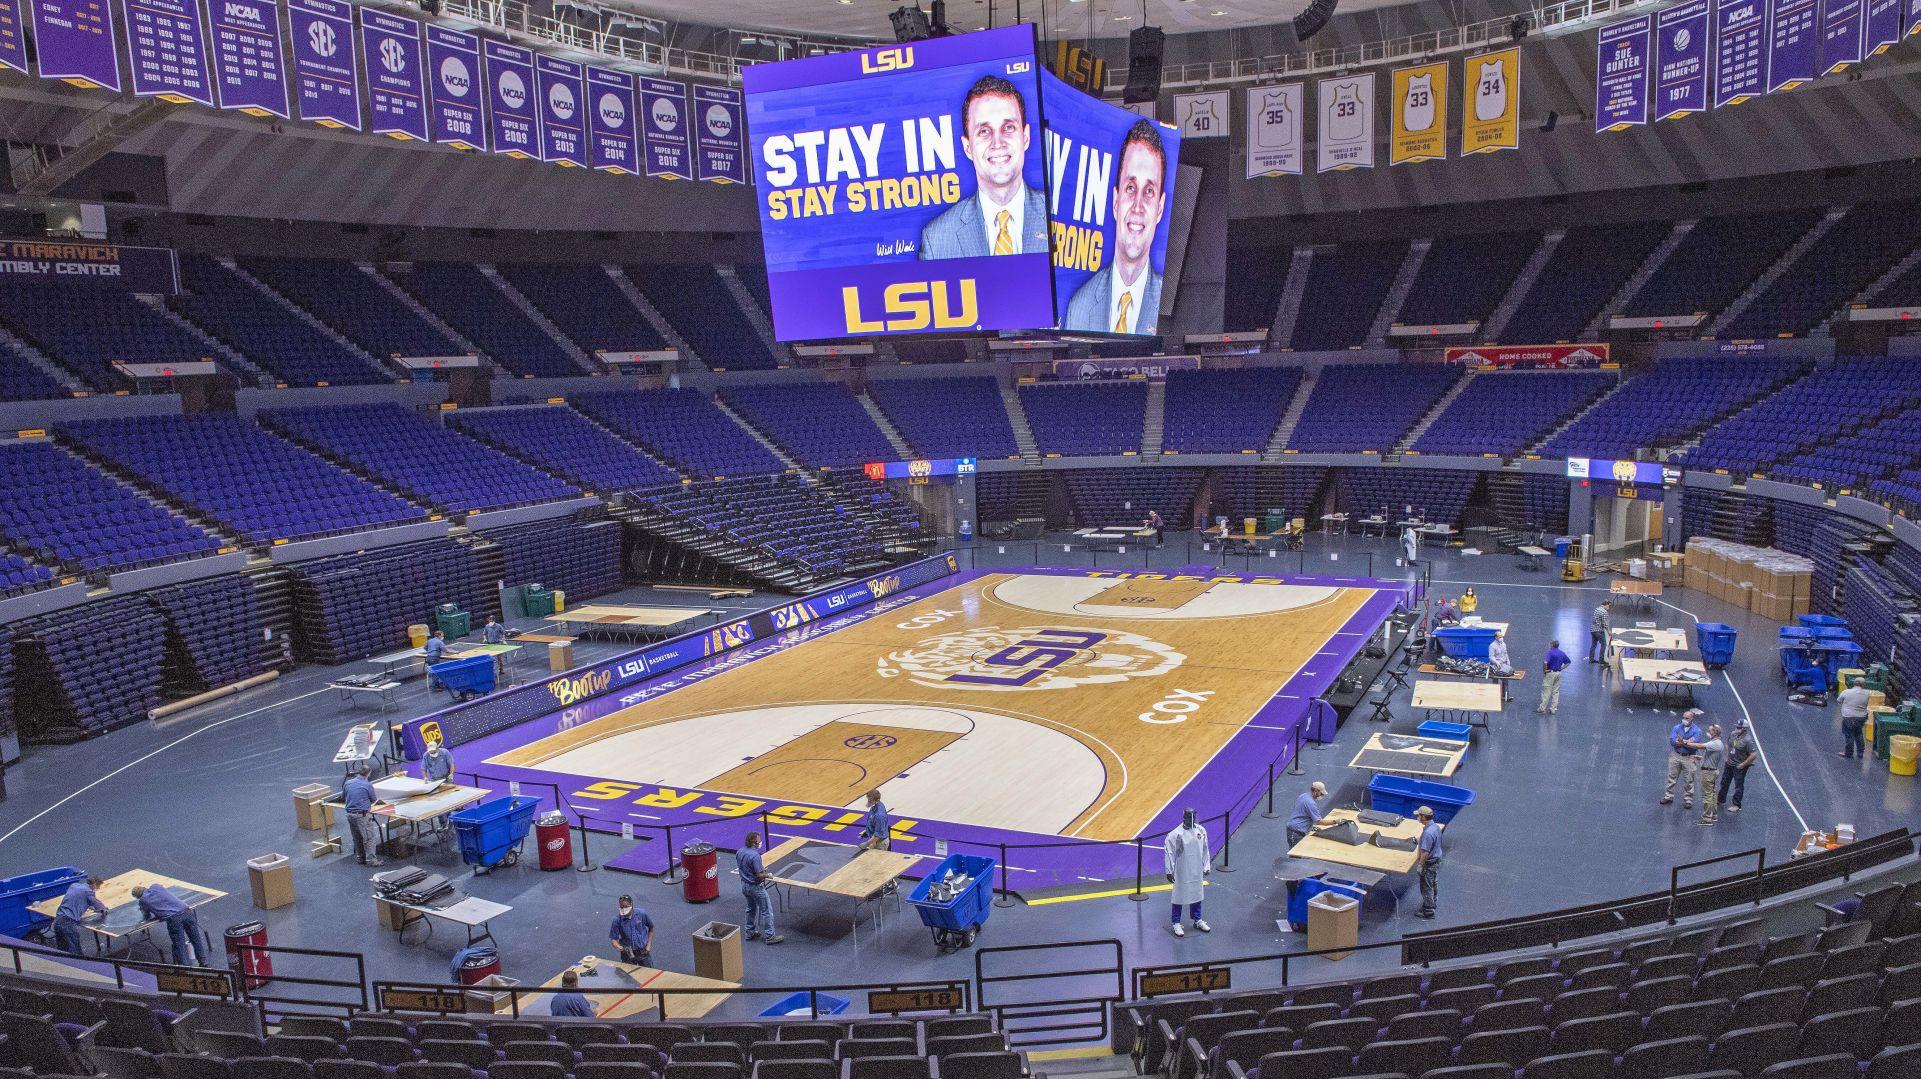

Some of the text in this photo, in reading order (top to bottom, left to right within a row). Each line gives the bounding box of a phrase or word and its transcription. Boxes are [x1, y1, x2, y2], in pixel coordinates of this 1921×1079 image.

[225, 2, 261, 22] NCAA
[1728, 5, 1753, 23] NCAA
[375, 17, 405, 30] GYMNASTICS
[308, 20, 337, 57] SEC
[379, 38, 406, 73] SEC
[861, 47, 914, 75] LSU
[1614, 47, 1632, 61] SUE
[1006, 61, 1030, 75] LSU
[1606, 55, 1640, 73] GUNTER
[1662, 63, 1700, 80] RUNNER-UP
[445, 74, 469, 89] NCAA
[1482, 79, 1500, 97] 34
[502, 87, 525, 101] NCAA
[1410, 91, 1429, 108] 33
[1669, 85, 1691, 101] 1977
[553, 99, 574, 112] NCAA
[1337, 101, 1356, 118] 33
[443, 108, 473, 121] SUPER SIX
[602, 110, 625, 121] NCAA
[655, 113, 678, 124] NCAA
[1266, 109, 1284, 125] 35
[446, 118, 472, 135] 2008
[501, 119, 529, 132] SUPER SIX
[709, 119, 731, 130] NCAA
[1193, 116, 1210, 131] 40
[504, 129, 528, 144] 2009
[551, 130, 577, 142] SUPER SIX
[601, 138, 627, 149] SUPER SIX
[555, 139, 575, 154] 2013
[654, 146, 681, 156] SUPER SIX
[762, 115, 956, 188] STAY IN
[604, 148, 625, 161] 2014
[658, 155, 678, 168] 2016
[707, 152, 734, 161] SUPER SIX
[711, 160, 731, 172] 2017
[1072, 144, 1113, 226] IN
[767, 172, 960, 221] STAY STRONG
[13, 241, 119, 261] MARAVICH
[1050, 220, 1104, 273] RONG
[55, 262, 121, 276] CENTER
[842, 278, 979, 334] LSU
[1521, 351, 1552, 359] COOKED
[957, 464, 975, 472] BTR
[1617, 487, 1638, 498] LSU
[1086, 571, 1284, 585] TIGERS
[827, 595, 845, 609] LSU
[896, 608, 964, 630] COX
[618, 659, 646, 679] LSU
[649, 651, 679, 665] BASKETBALL
[944, 629, 1108, 687] LSU
[1138, 688, 1216, 725] COX
[571, 781, 918, 842] TIGERS
